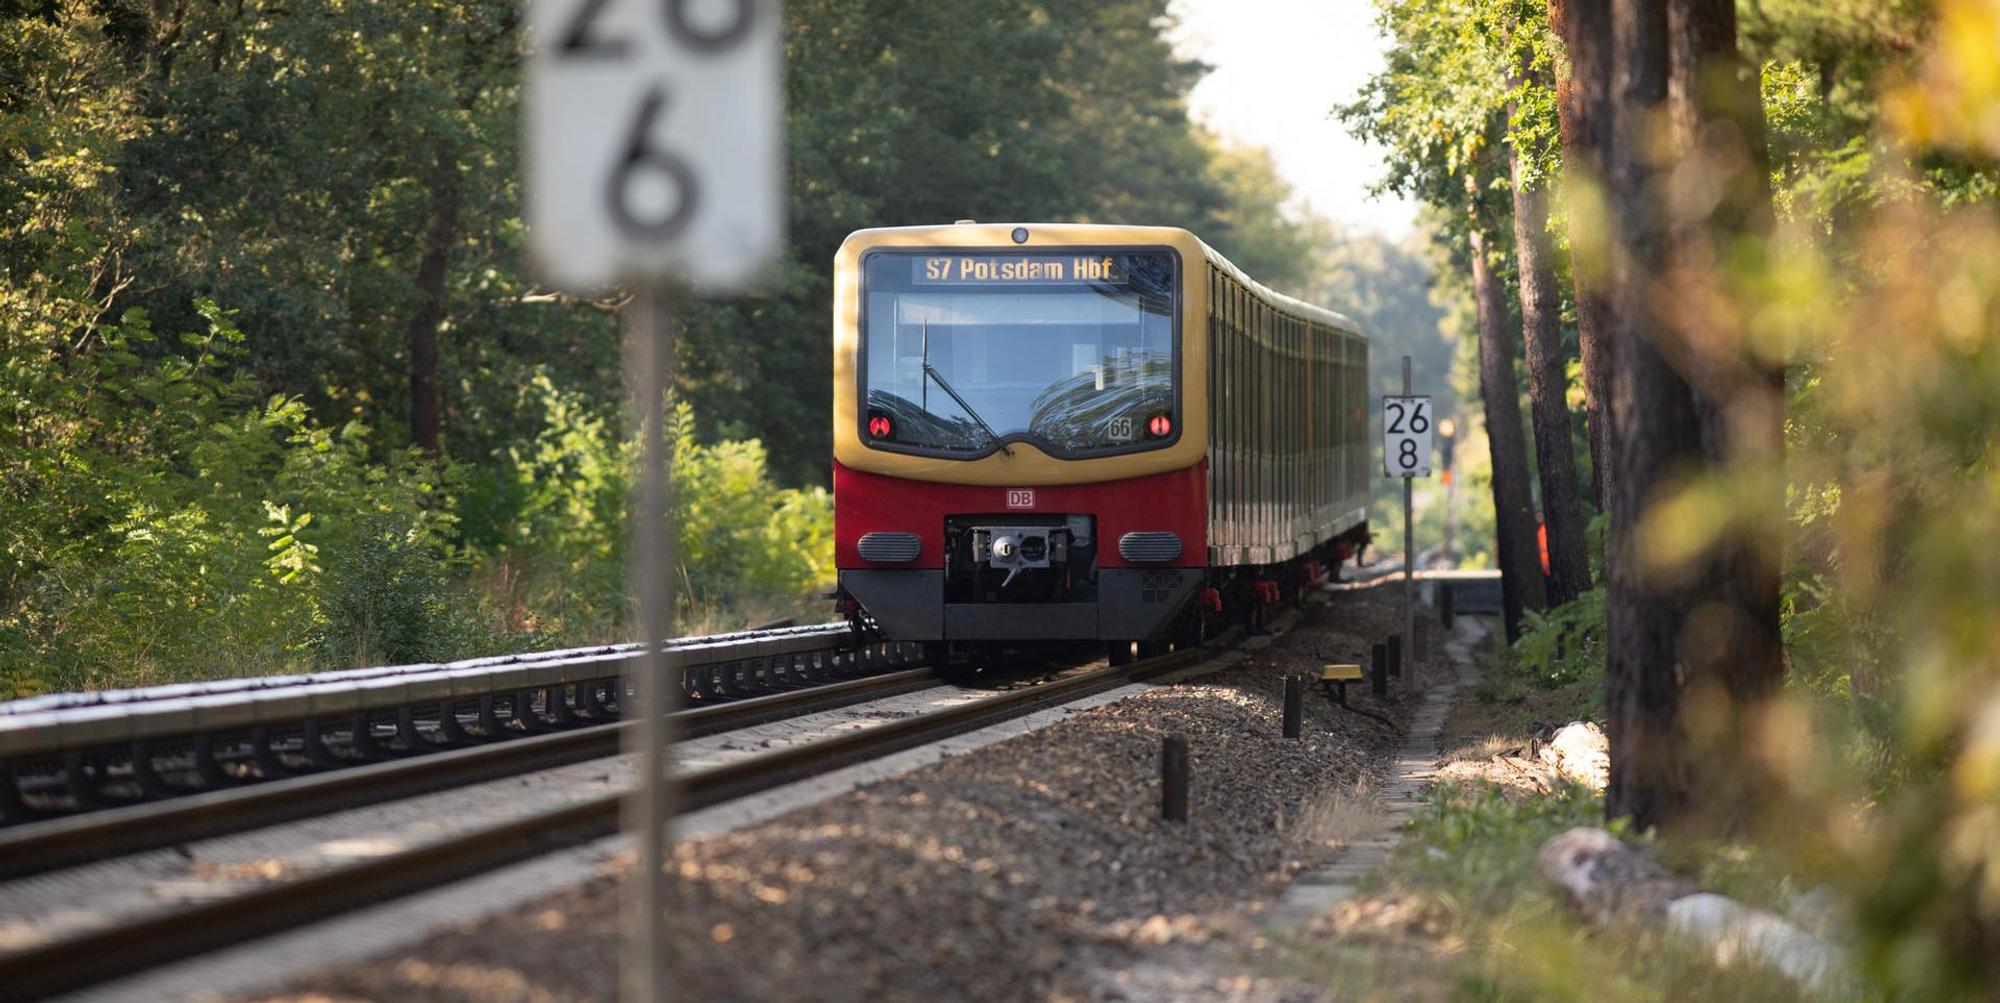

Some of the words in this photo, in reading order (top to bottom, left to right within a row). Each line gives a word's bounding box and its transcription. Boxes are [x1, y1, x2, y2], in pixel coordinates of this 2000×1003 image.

[602, 80, 704, 248] 6
[926, 257, 952, 280] S7
[960, 257, 1063, 280] Potsdam
[1073, 257, 1112, 280] Hbf
[1110, 419, 1130, 437] 66
[1386, 403, 1429, 434] 26
[1398, 438, 1418, 469] 8
[1010, 491, 1031, 505] DB
